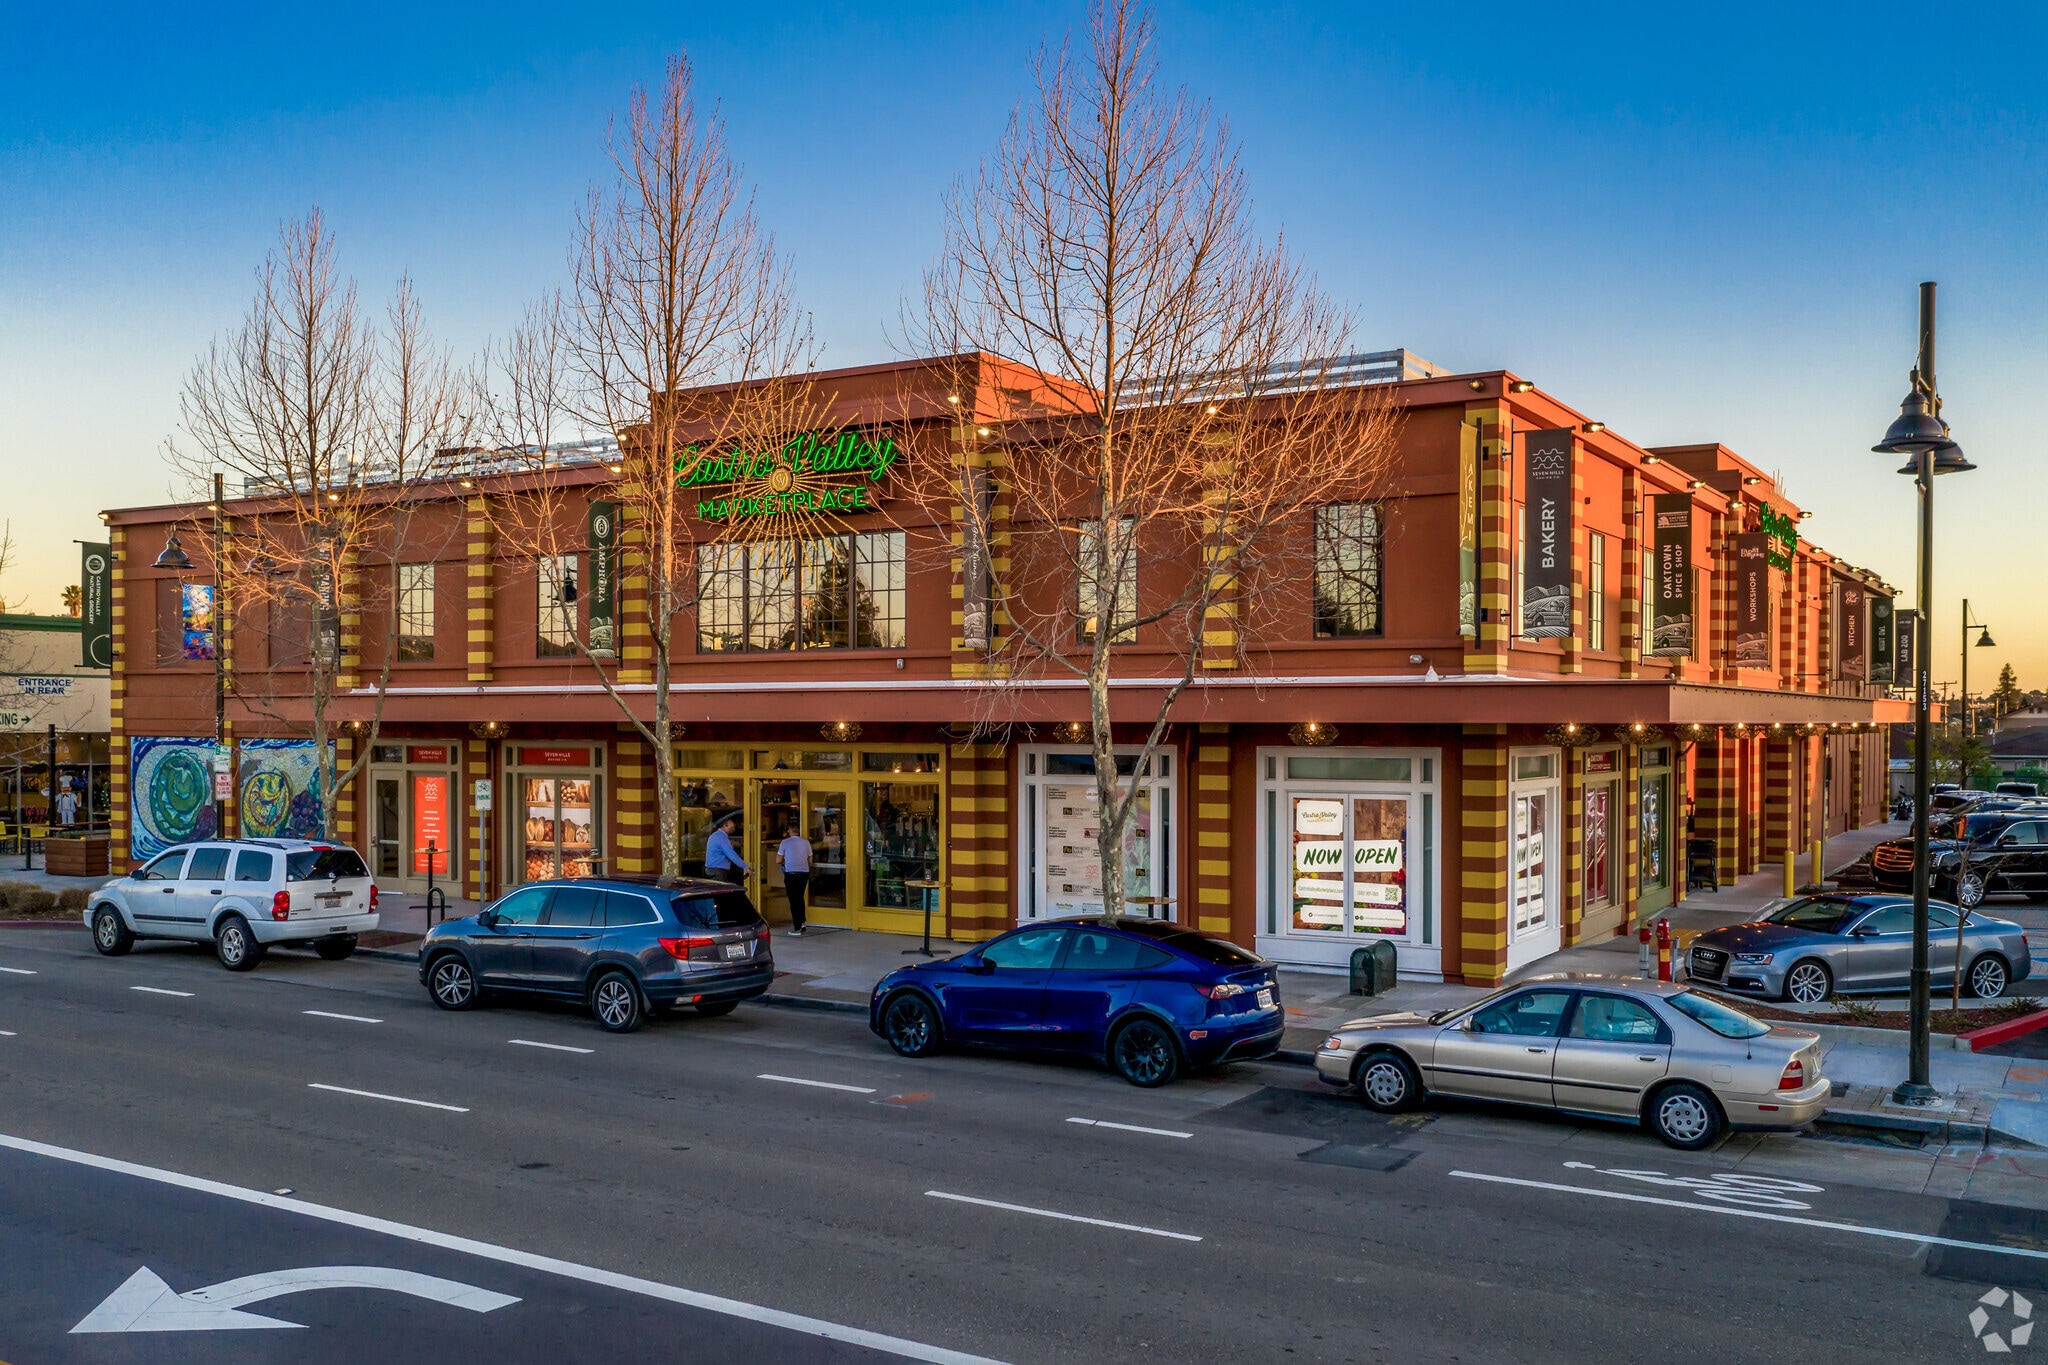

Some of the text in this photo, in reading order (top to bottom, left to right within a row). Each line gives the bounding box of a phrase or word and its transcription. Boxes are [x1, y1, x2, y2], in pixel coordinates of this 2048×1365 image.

[672, 430, 898, 487] Castro Valley
[698, 486, 868, 520] MARKETPLACE
[1541, 498, 1555, 569] BAKERY
[598, 542, 607, 603] AMPHORA
[1663, 544, 1672, 599] OAKTOWN
[1675, 573, 1683, 598] SPICE
[1900, 635, 1908, 662] LAB 200
[18, 678, 71, 687] ENTRANCE
[0, 713, 18, 725] ING
[1303, 846, 1398, 865] NOW OPEN
